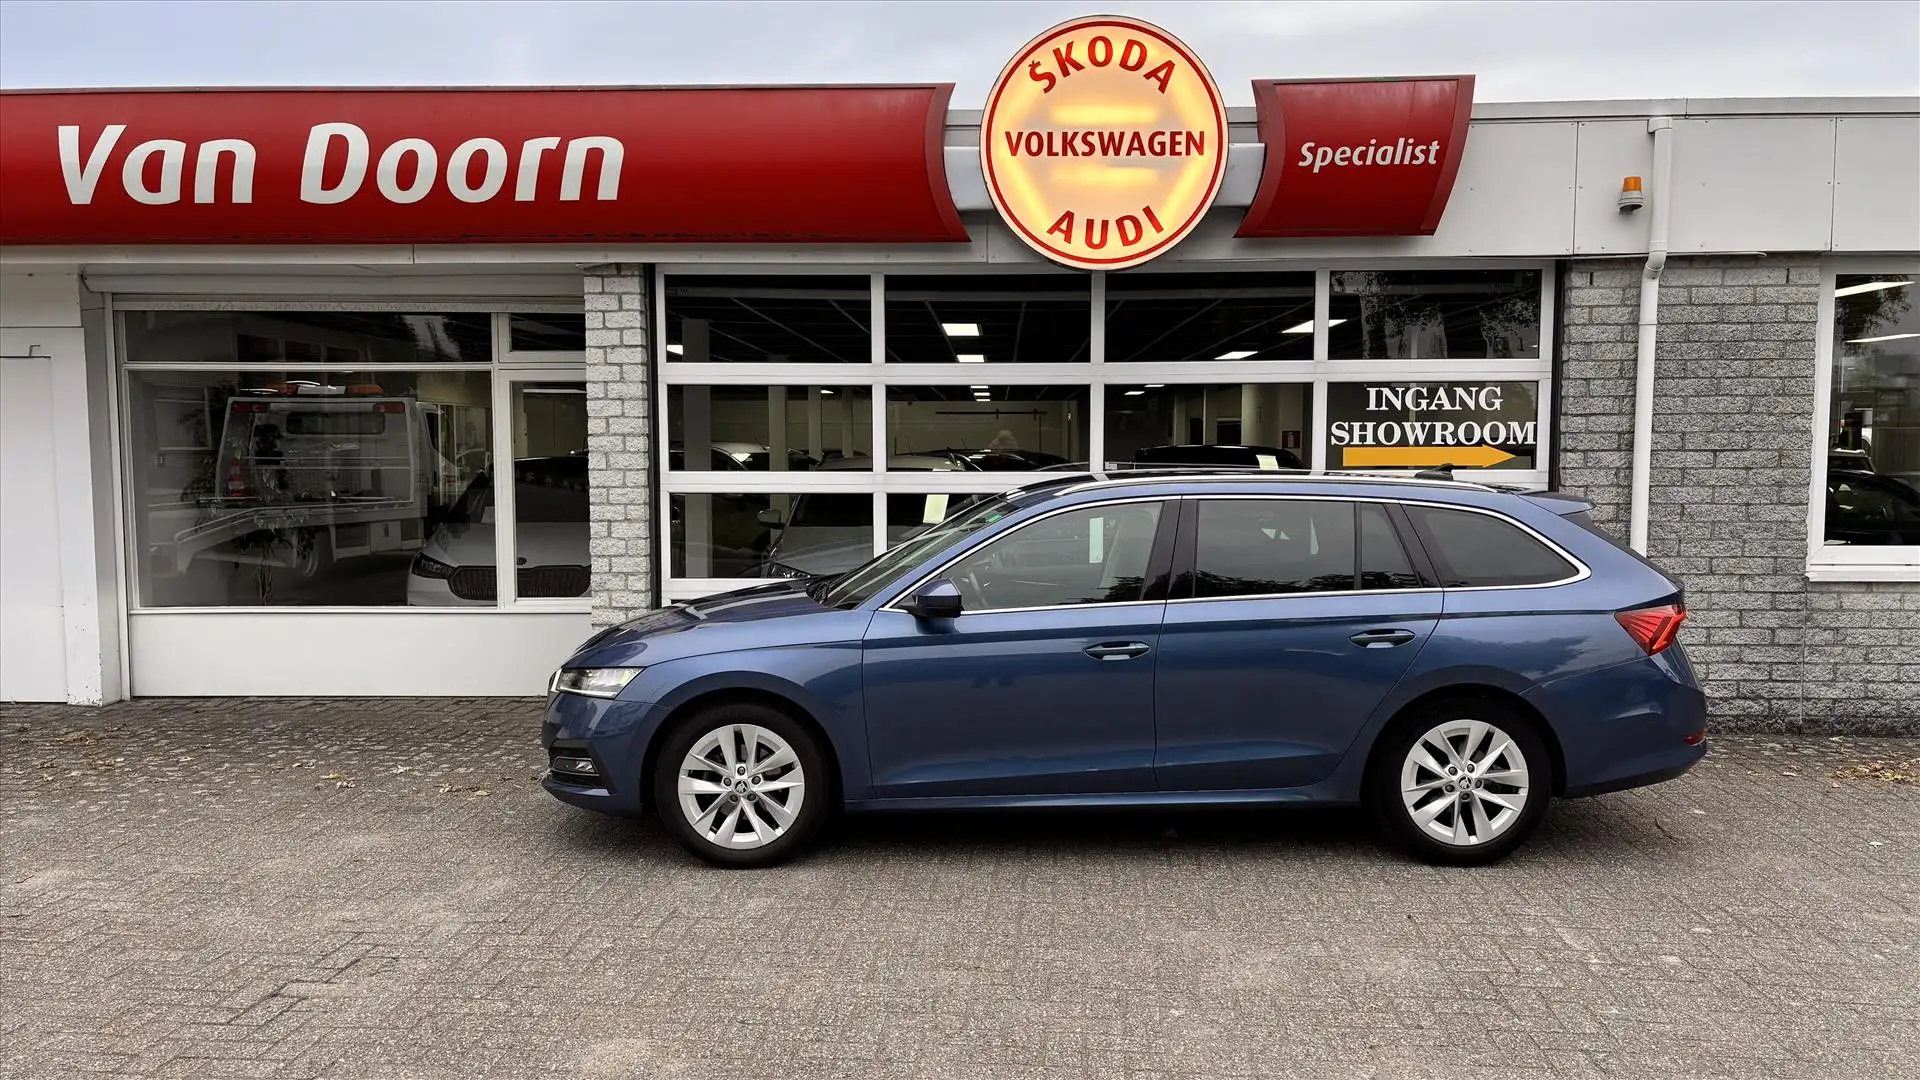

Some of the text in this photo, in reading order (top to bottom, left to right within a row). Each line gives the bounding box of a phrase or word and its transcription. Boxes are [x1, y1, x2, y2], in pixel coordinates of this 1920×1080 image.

[1028, 35, 1176, 94] ŠKODA
[1005, 130, 1205, 157] VOLKSWAGEN
[1297, 137, 1441, 174] Specialist
[57, 122, 625, 205] Van Doorn
[1046, 205, 1164, 250] AUDI
[1365, 386, 1504, 411] INGANG
[1330, 421, 1537, 446] SHOWROOM
